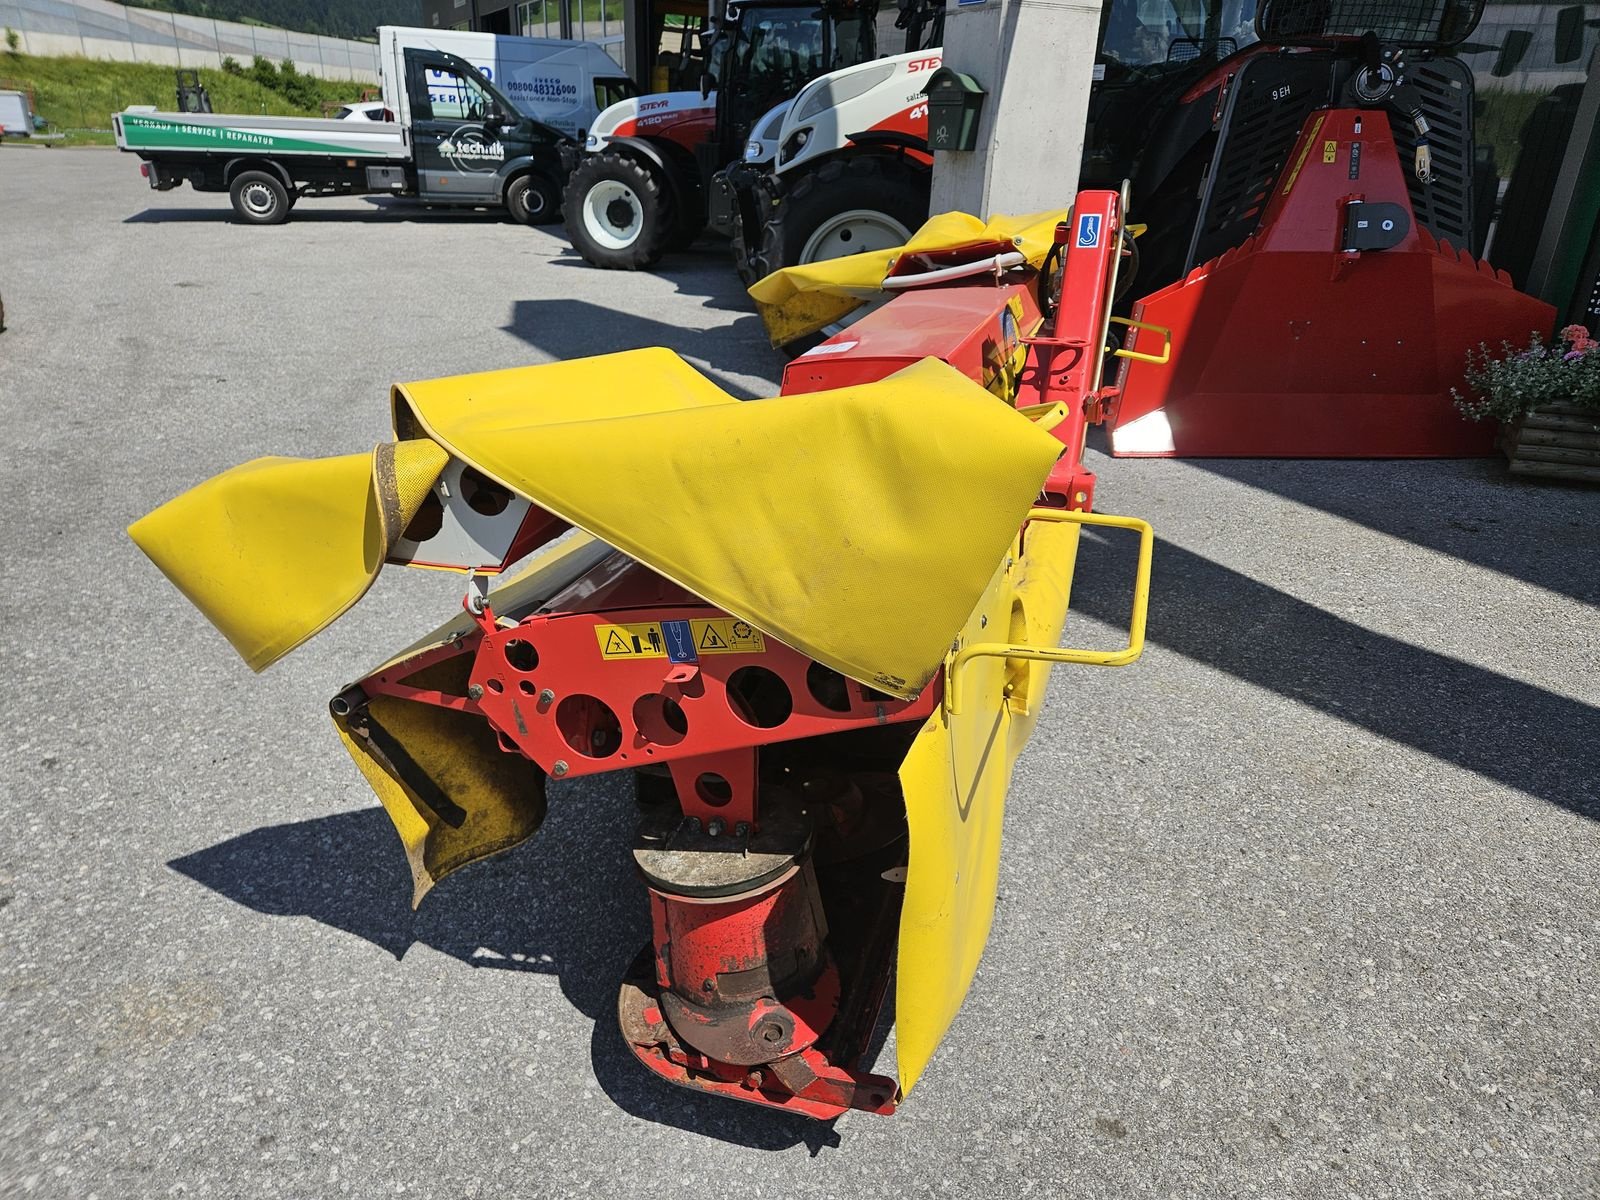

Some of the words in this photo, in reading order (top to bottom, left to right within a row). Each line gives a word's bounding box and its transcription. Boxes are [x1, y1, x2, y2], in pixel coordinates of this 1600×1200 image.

[1272, 90, 1279, 100] 9
[1279, 85, 1291, 98] EH
[640, 100, 669, 111] STEYR
[637, 115, 662, 126] 4120
[133, 118, 171, 130] VERKAUF
[181, 125, 217, 138] SERVICE
[226, 131, 274, 146] REPARATUR
[456, 140, 505, 155] technik
